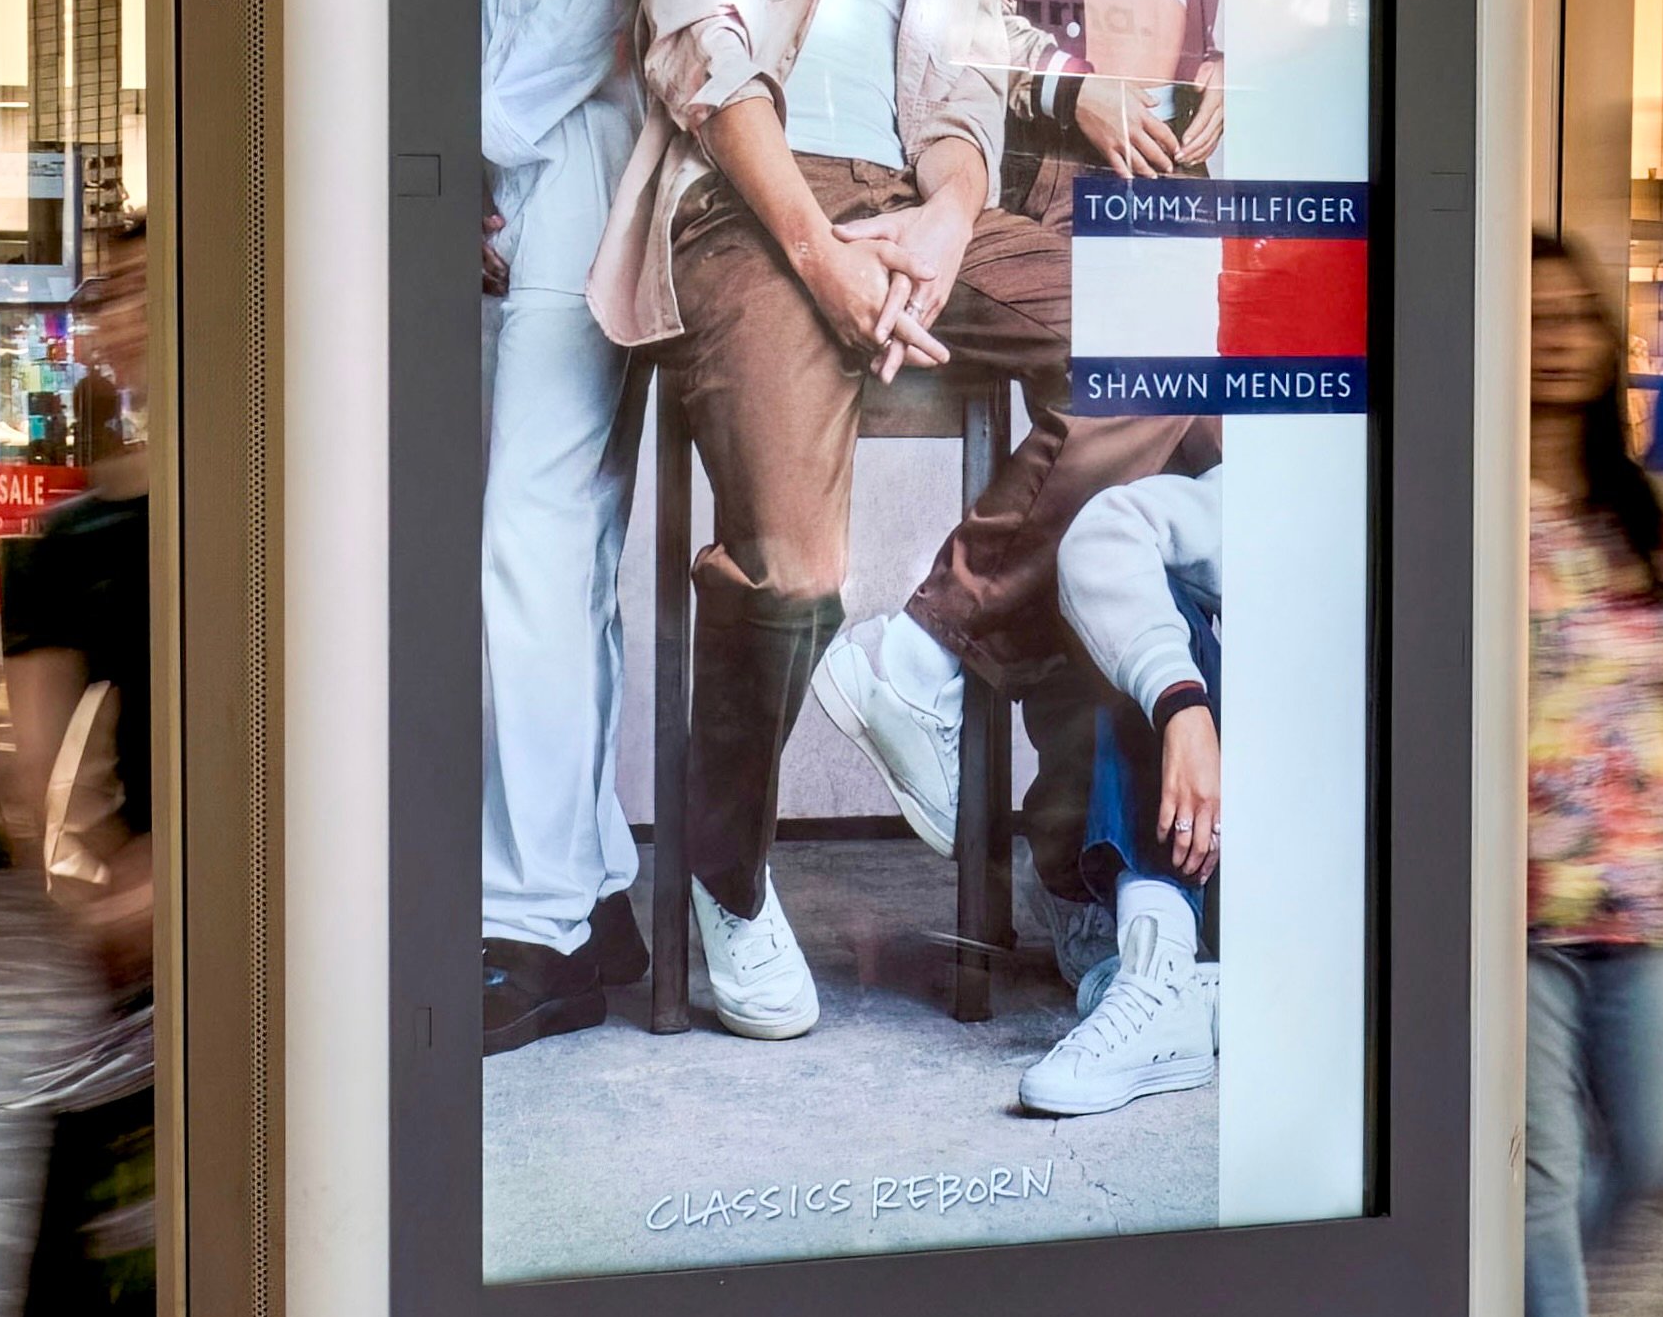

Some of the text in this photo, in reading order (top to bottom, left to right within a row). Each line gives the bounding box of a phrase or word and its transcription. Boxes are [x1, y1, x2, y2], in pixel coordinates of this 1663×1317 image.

[1084, 194, 1357, 224] TOMMY HILFIGER
[1088, 372, 1352, 400] SHAWN MENDES
[644, 1159, 1054, 1232] CLASSICS REBORN
